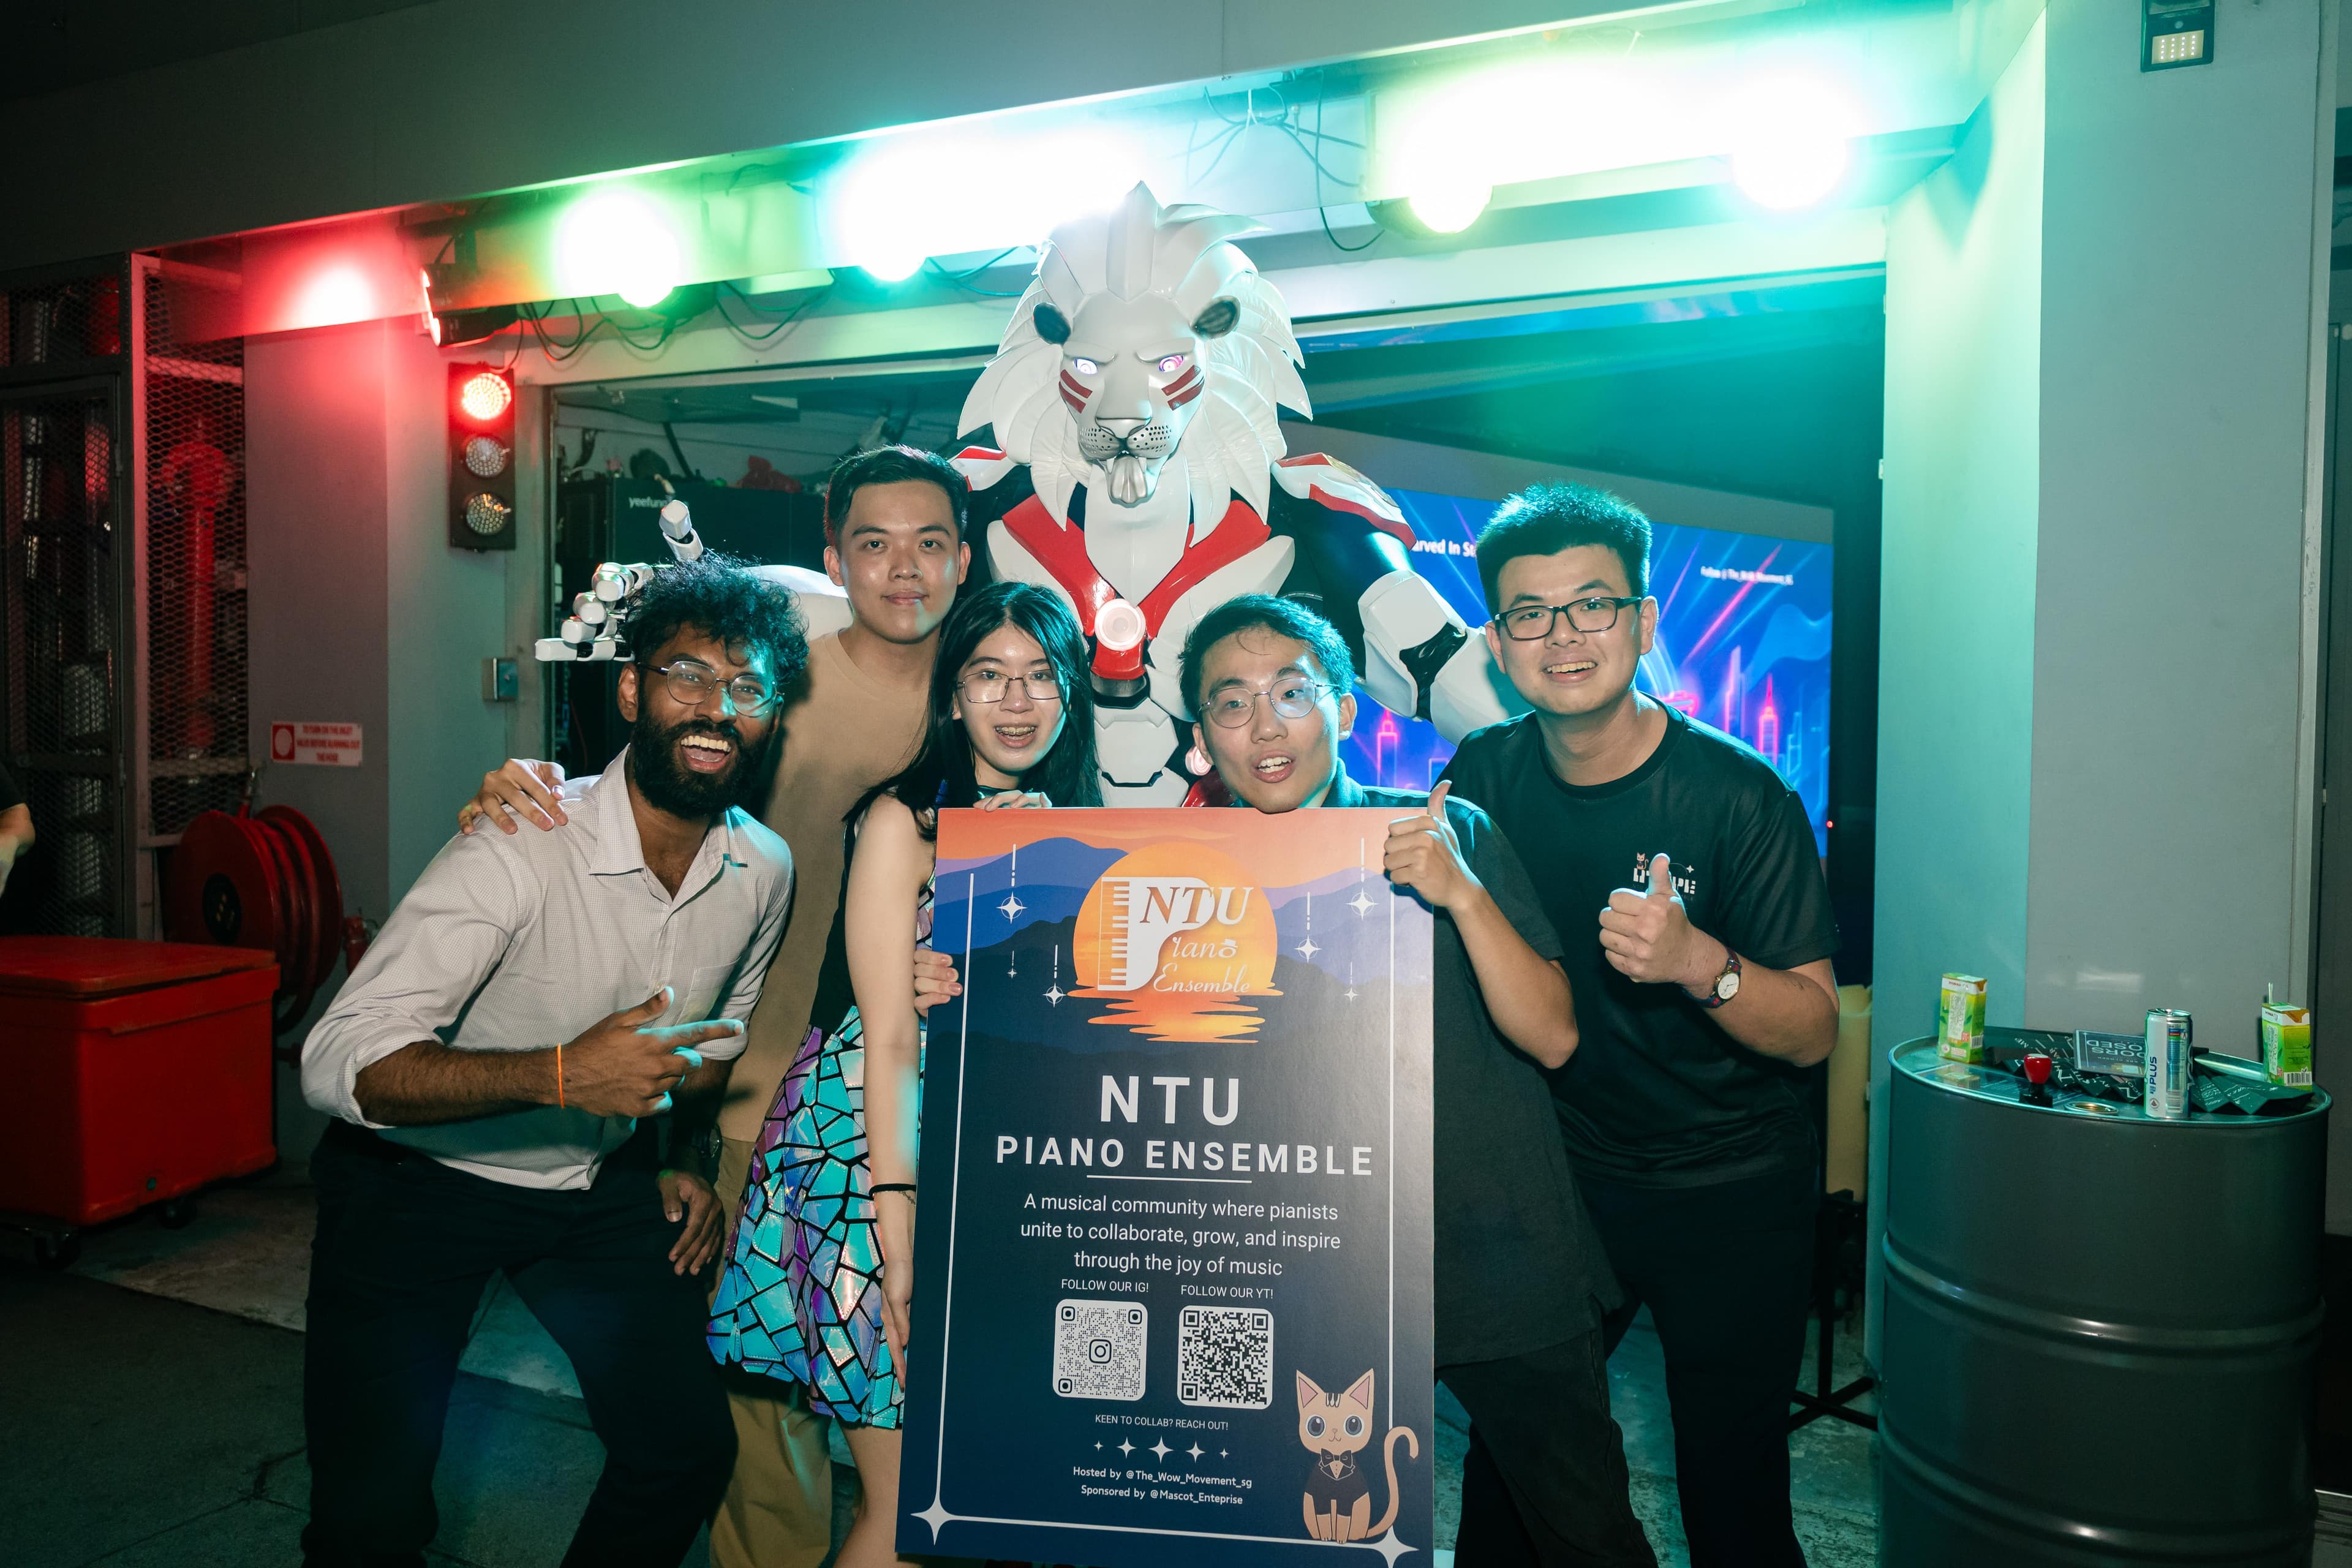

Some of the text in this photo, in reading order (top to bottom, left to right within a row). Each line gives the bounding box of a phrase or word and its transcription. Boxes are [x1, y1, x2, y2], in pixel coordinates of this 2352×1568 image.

[1412, 539, 1446, 554] arved
[1449, 540, 1460, 555] In
[1140, 887, 1254, 925] NTU
[1153, 963, 1250, 993] Ensemble
[1101, 1076, 1238, 1126] NTU
[997, 1136, 1372, 1176] PIANO ENSEMBLE
[1024, 1194, 1338, 1221] A musical community where pianists
[1022, 1222, 1340, 1251] unite to collaborate, grow, and inspire
[1074, 1251, 1282, 1275] through the joy of music
[1062, 1279, 1148, 1292] FOLLOW OUR IG!
[1182, 1285, 1273, 1298] FOLLOW OUR YT!
[1096, 1415, 1117, 1423] KEEN
[1135, 1417, 1173, 1427] COLLAB?
[1176, 1419, 1205, 1428] REACH
[1208, 1421, 1227, 1430] OUT!
[1074, 1467, 1106, 1477] Hosted
[1110, 1469, 1121, 1480] by
[1082, 1485, 1243, 1504] Sponsored by @Mascot_Enteprise
